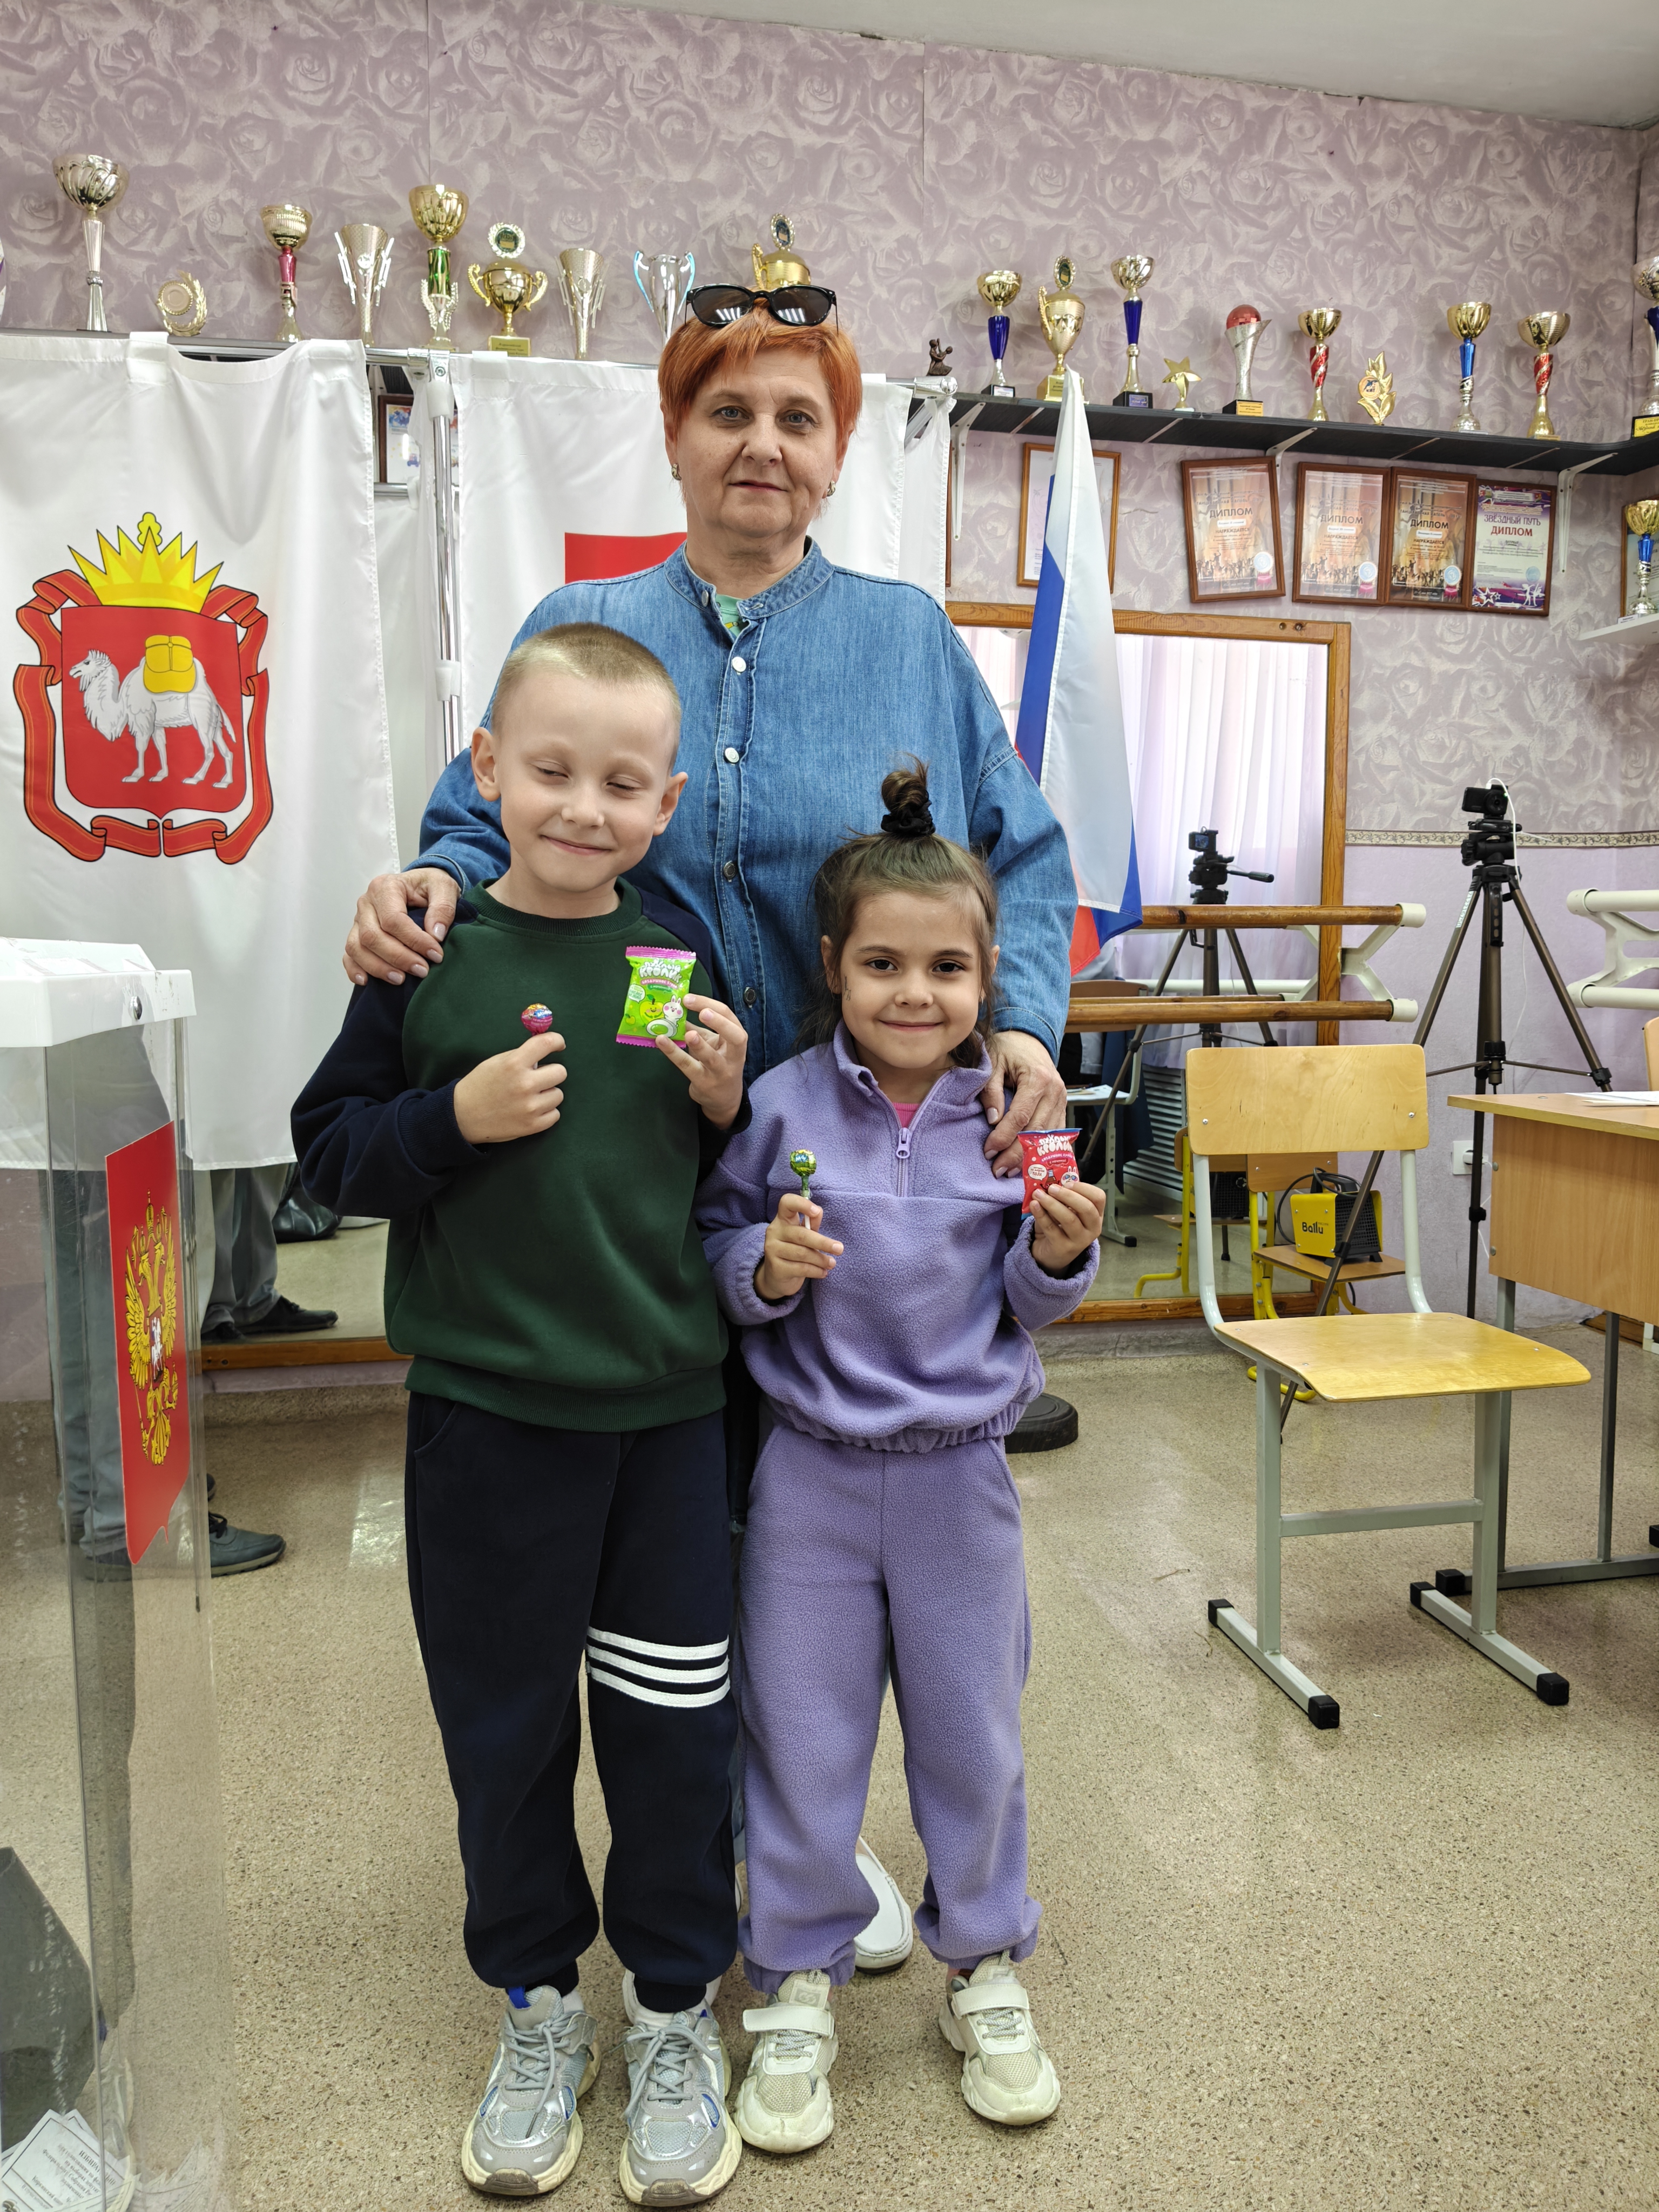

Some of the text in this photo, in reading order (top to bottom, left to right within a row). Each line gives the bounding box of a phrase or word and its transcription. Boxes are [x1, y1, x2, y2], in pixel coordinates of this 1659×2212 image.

[1210, 508, 1252, 518] ДИПЛОМ
[1320, 515, 1363, 524] ДИПЛОМ
[1410, 519, 1448, 529] ДИПЛОМ
[1484, 514, 1541, 525] ЗВЁЗДНЫЙ ПУТЬ
[1491, 526, 1533, 536] ДИПЛОМ
[639, 966, 683, 983] КРОЛИК
[1302, 1222, 1323, 1234] Ballu
